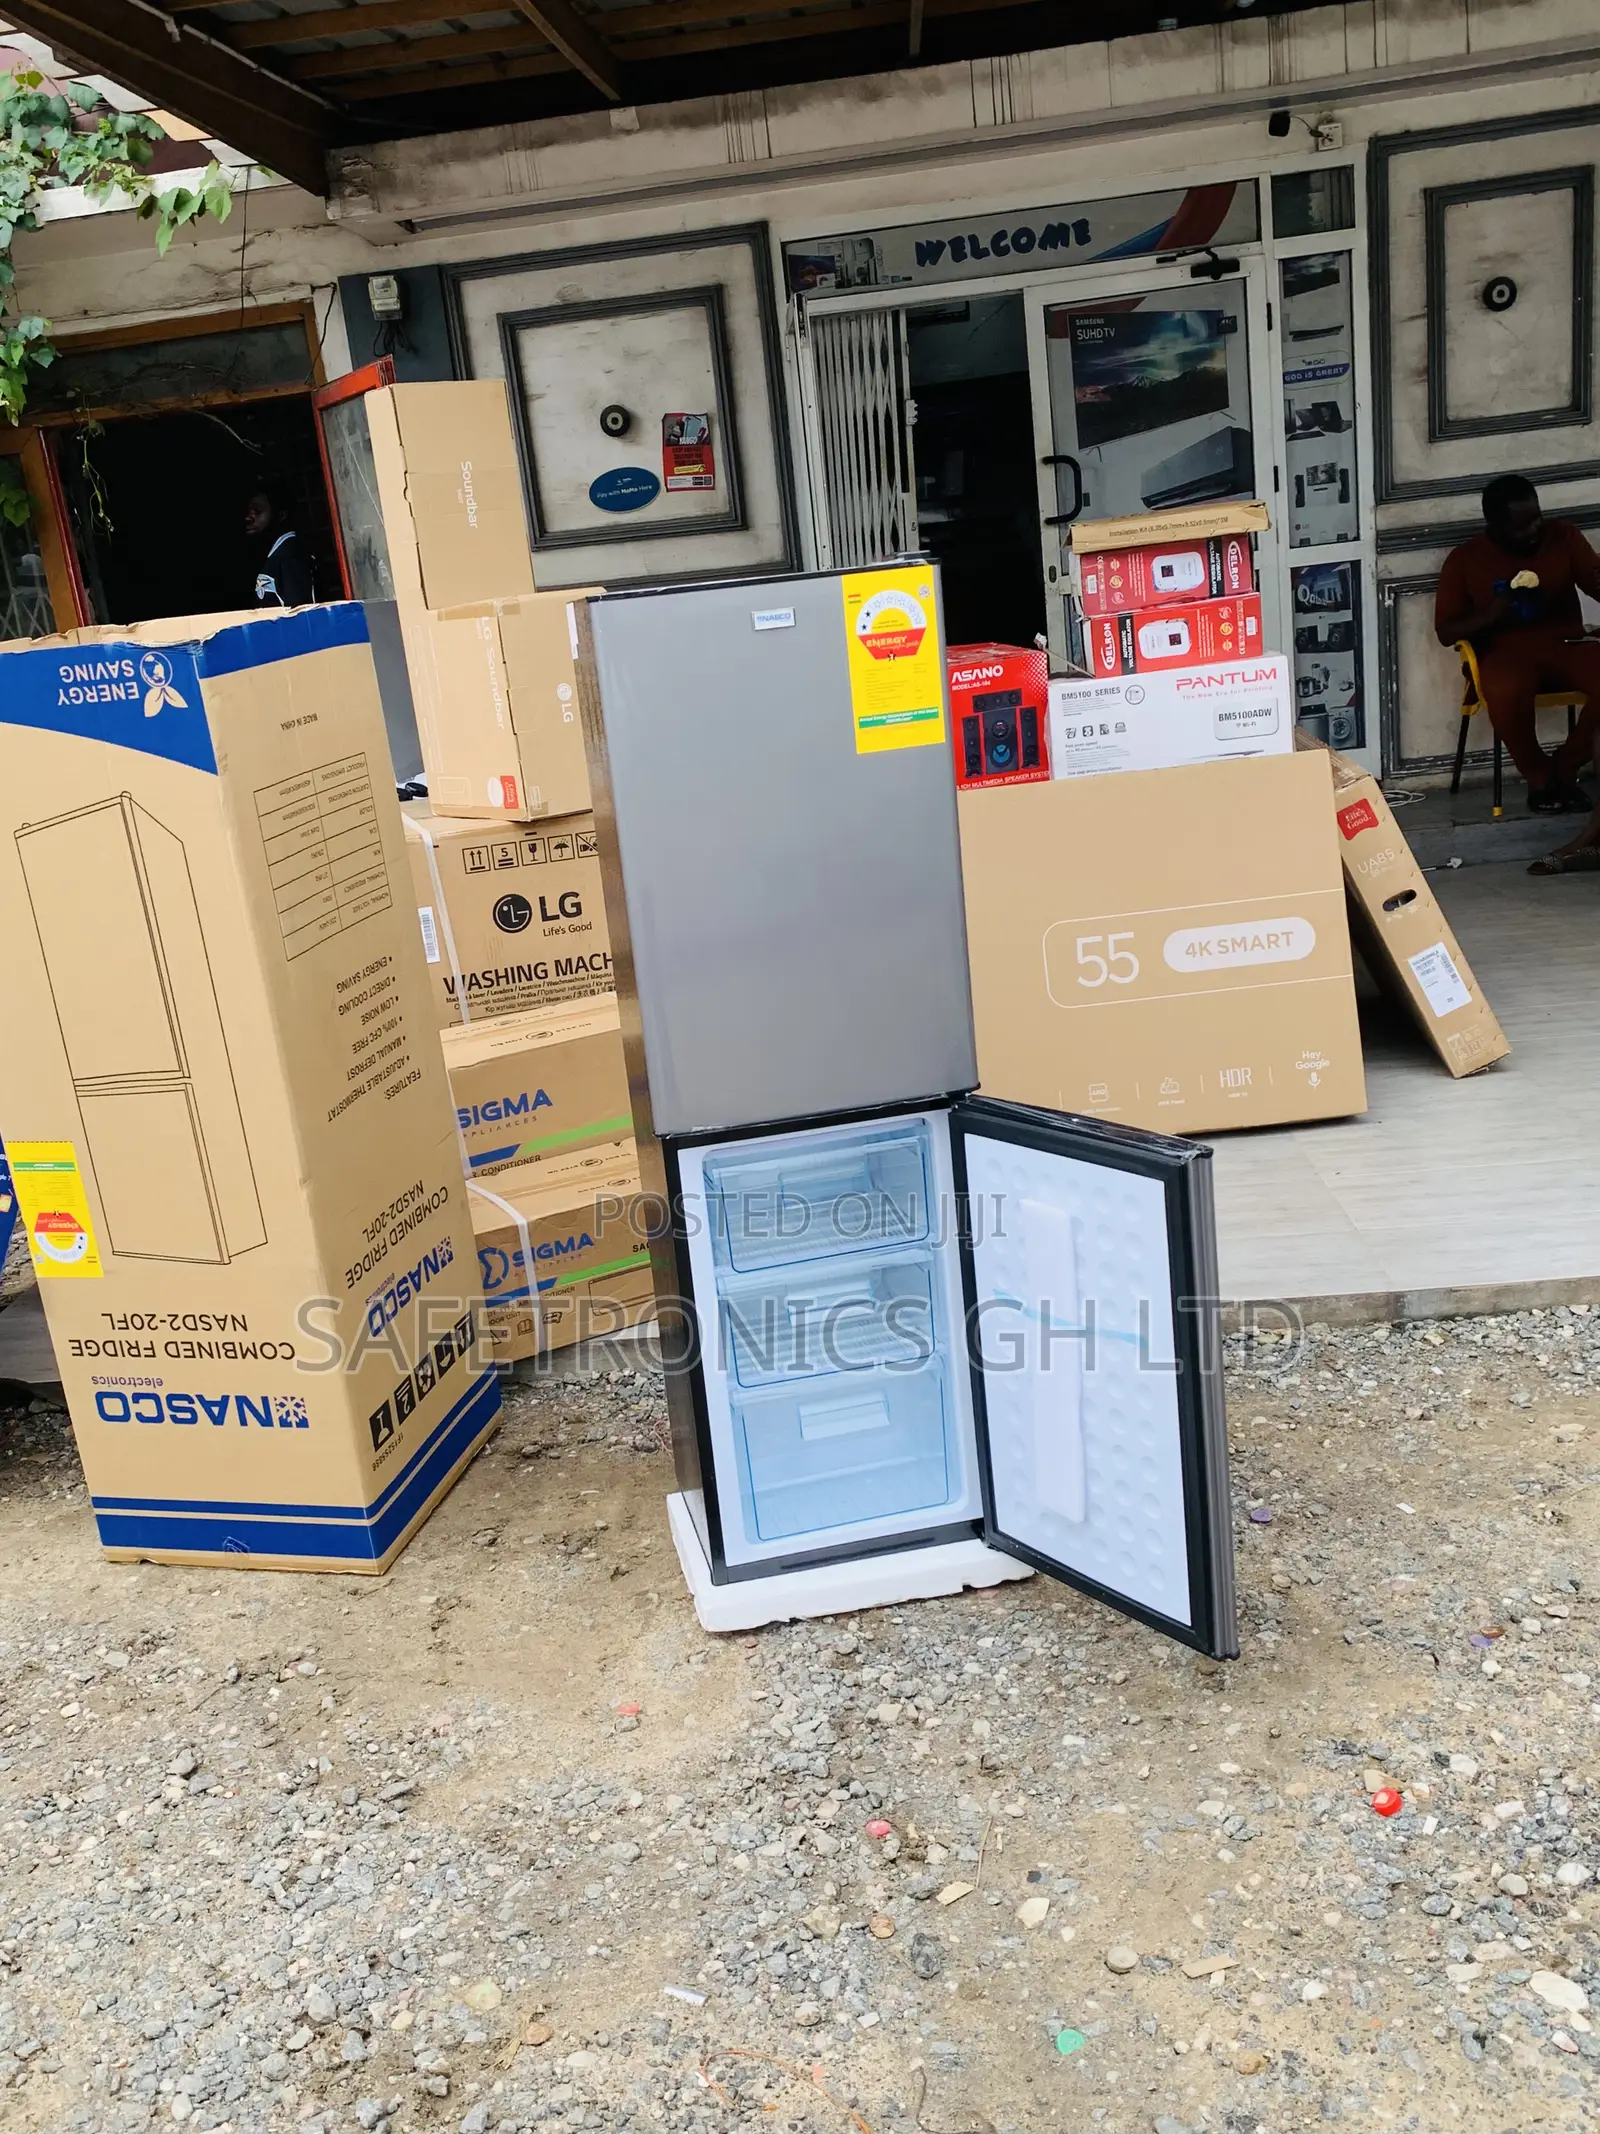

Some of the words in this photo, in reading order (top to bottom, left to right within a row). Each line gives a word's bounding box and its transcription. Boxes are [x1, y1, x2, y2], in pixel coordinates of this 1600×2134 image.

[915, 218, 1091, 267] WELCOME
[460, 461, 478, 529] Soundbar
[621, 487, 638, 495] MoMo
[1109, 528, 1138, 537] Installation
[1229, 546, 1240, 589] DELRON
[866, 636, 907, 648] ENERGY
[1103, 622, 1113, 663] DELRON
[59, 660, 135, 683] SAVING
[481, 617, 491, 640] LG
[487, 647, 504, 729] Soundbar
[951, 664, 1004, 683] ASANO
[1176, 668, 1277, 691] PANTUM
[57, 681, 140, 706] ENERGY
[1061, 690, 1092, 701] BM5100
[1095, 686, 1121, 697] SERIES
[296, 718, 302, 727] IN
[303, 712, 318, 725] MADE
[561, 703, 574, 723] LG
[1218, 708, 1272, 722] BM5100ADW
[280, 720, 296, 731] CHINA
[972, 778, 1003, 788] MULTIMEDIA
[1005, 773, 1029, 784] SPEAKER
[1345, 808, 1366, 822] Life's
[1347, 815, 1372, 829] Good.
[1357, 848, 1395, 873] UA85
[538, 891, 583, 922] LG
[542, 926, 566, 937] Life's
[568, 922, 593, 934] Good
[1185, 940, 1212, 958] 4K
[1217, 931, 1294, 955] SMART
[362, 956, 388, 977] ENERGY
[1076, 931, 1140, 987] 55
[336, 971, 362, 994] SAVING
[369, 976, 391, 994] DIRECT
[443, 961, 549, 994] WASHING
[546, 976, 585, 987] Waschmaschine
[338, 990, 368, 1016] COOLING
[380, 996, 395, 1014] LOW
[360, 1005, 380, 1026] NOISE
[383, 1016, 398, 1033] 100%
[352, 1035, 369, 1055] FREE
[370, 1027, 383, 1042] CFC
[376, 1035, 403, 1060] MANUAL
[1302, 1050, 1321, 1061] Hey
[346, 1052, 377, 1082] DEFROST
[367, 1055, 405, 1089] ADJUSTABLE
[1295, 1058, 1330, 1070] Google
[384, 1068, 422, 1100] FEATURES:
[1219, 1067, 1252, 1088] HDR
[327, 1082, 367, 1122] THERMOSTAT
[457, 1089, 553, 1128] SIGMA
[482, 1154, 542, 1177] CONDITIONER
[362, 1180, 424, 1243] NASD2-20FL
[389, 1186, 449, 1246] COMBINED
[512, 1232, 595, 1268] SIGMA
[345, 1237, 388, 1289] FRIDGE
[368, 1247, 440, 1337] NASCO
[101, 1313, 249, 1332] NASD2-20FL
[68, 1338, 157, 1359] FRIDGE
[165, 1341, 296, 1360] COMBINED
[91, 1376, 164, 1388] electronics
[95, 1391, 275, 1428] NASCO
